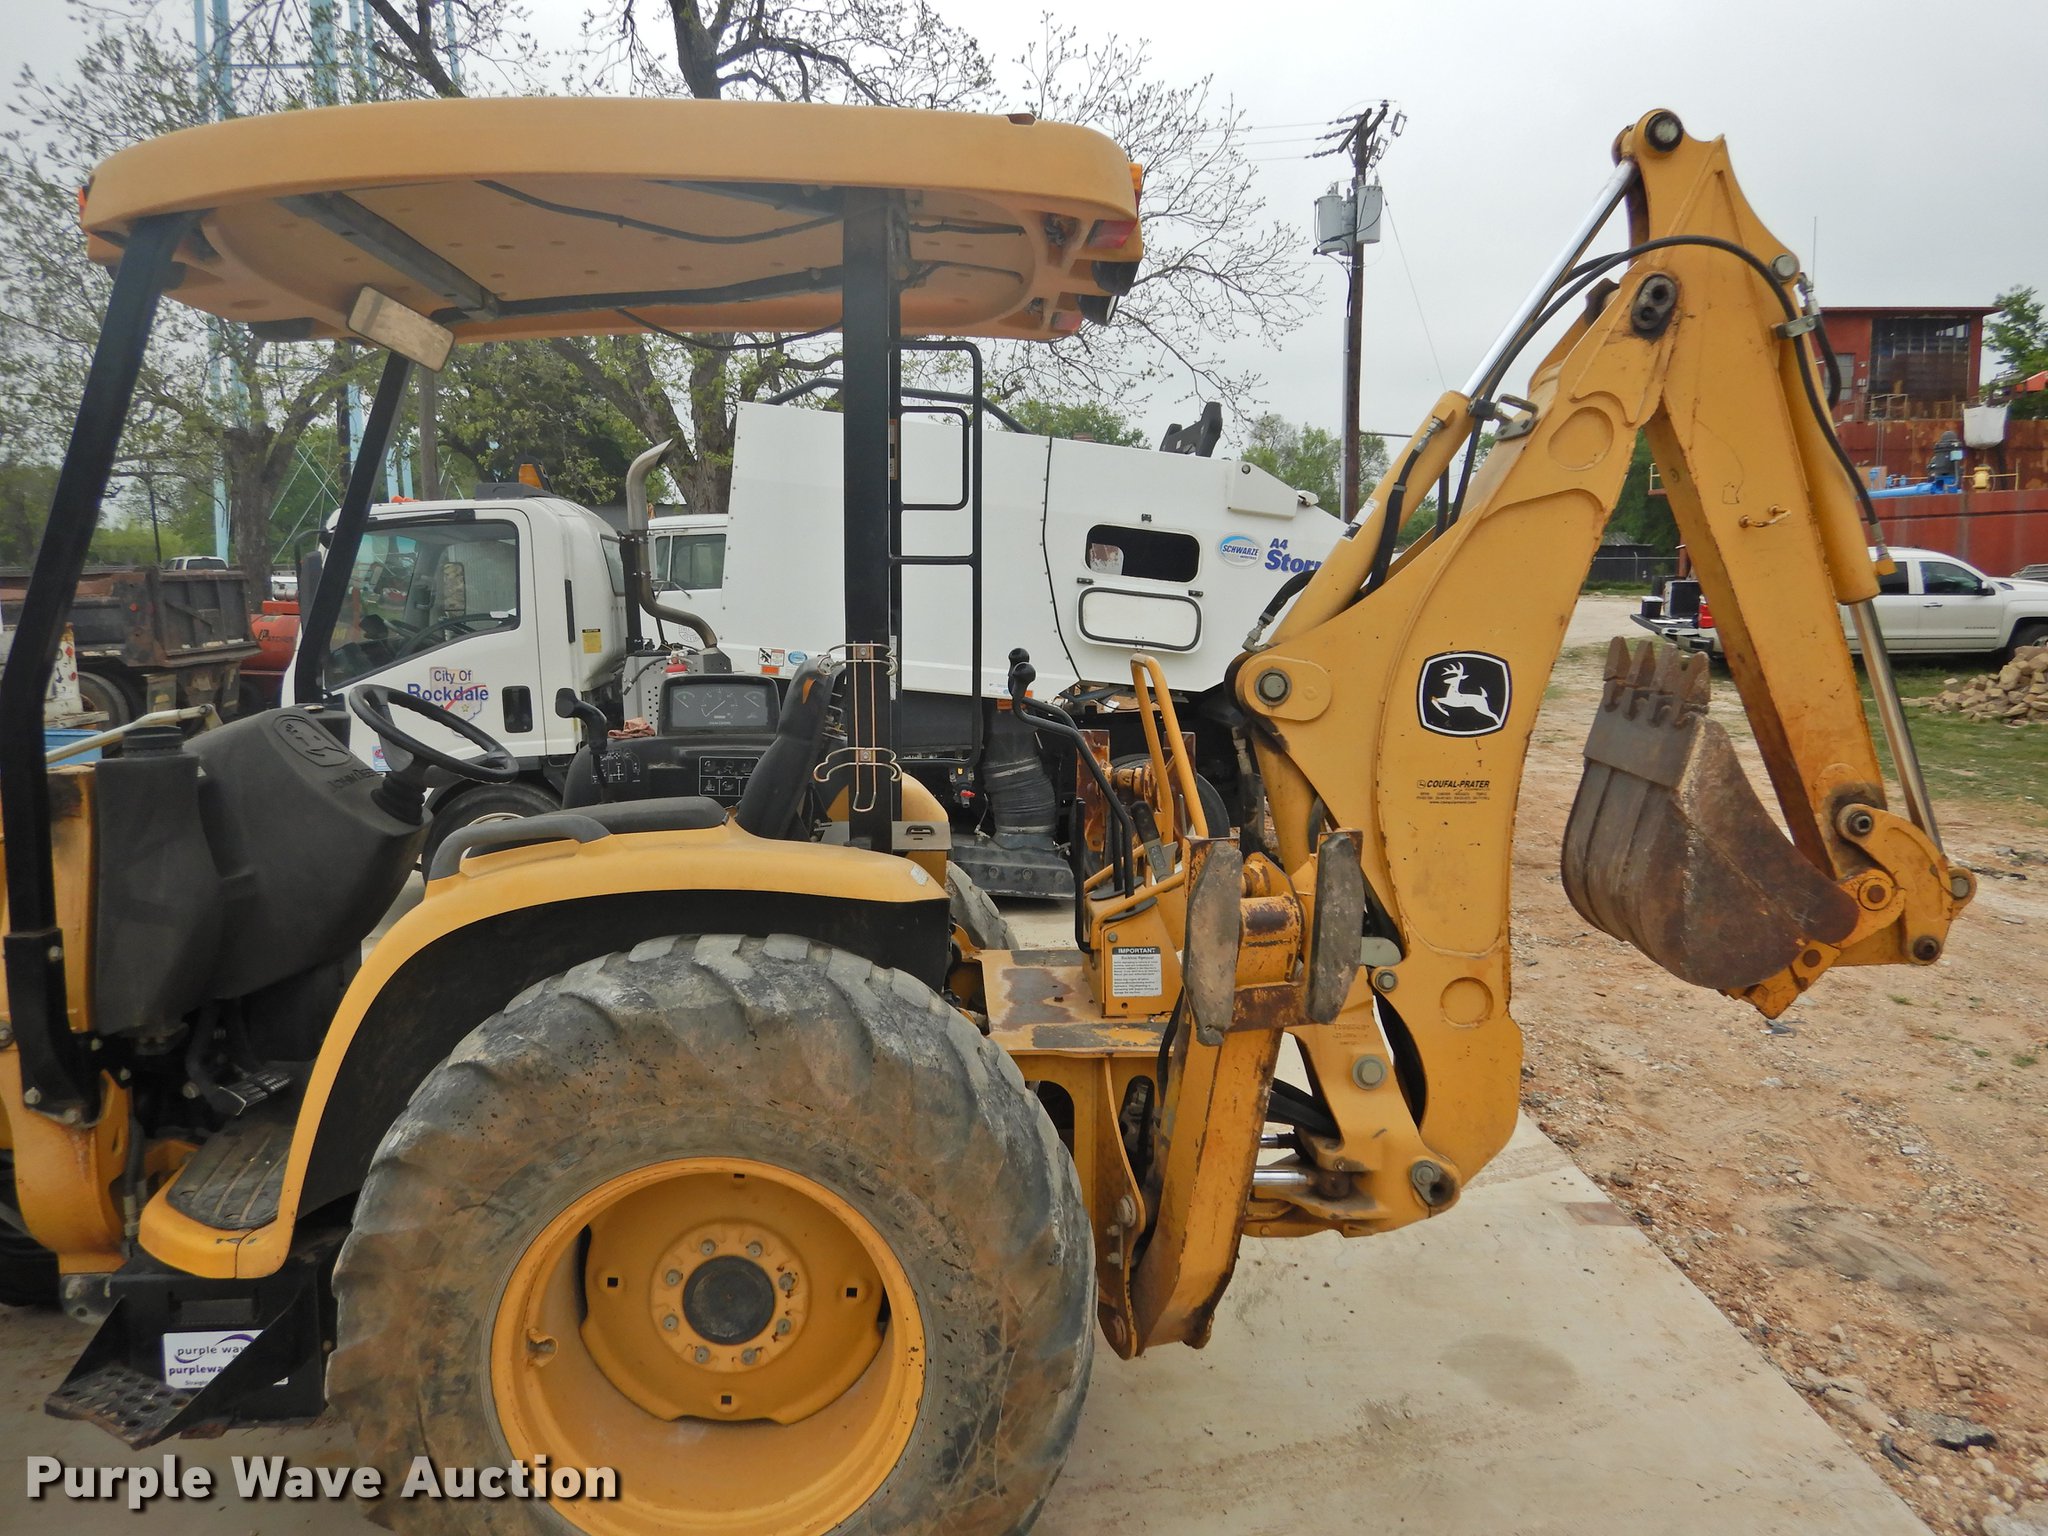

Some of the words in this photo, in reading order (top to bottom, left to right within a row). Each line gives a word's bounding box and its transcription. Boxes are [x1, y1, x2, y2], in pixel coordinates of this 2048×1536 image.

[1270, 538, 1288, 550] A4
[1222, 544, 1259, 556] SCHWARZE
[434, 670, 456, 684] City
[459, 670, 472, 681] Of
[1427, 780, 1490, 788] COUFAL-PRATER
[177, 1346, 217, 1356] purple
[168, 1365, 225, 1376] purplewa
